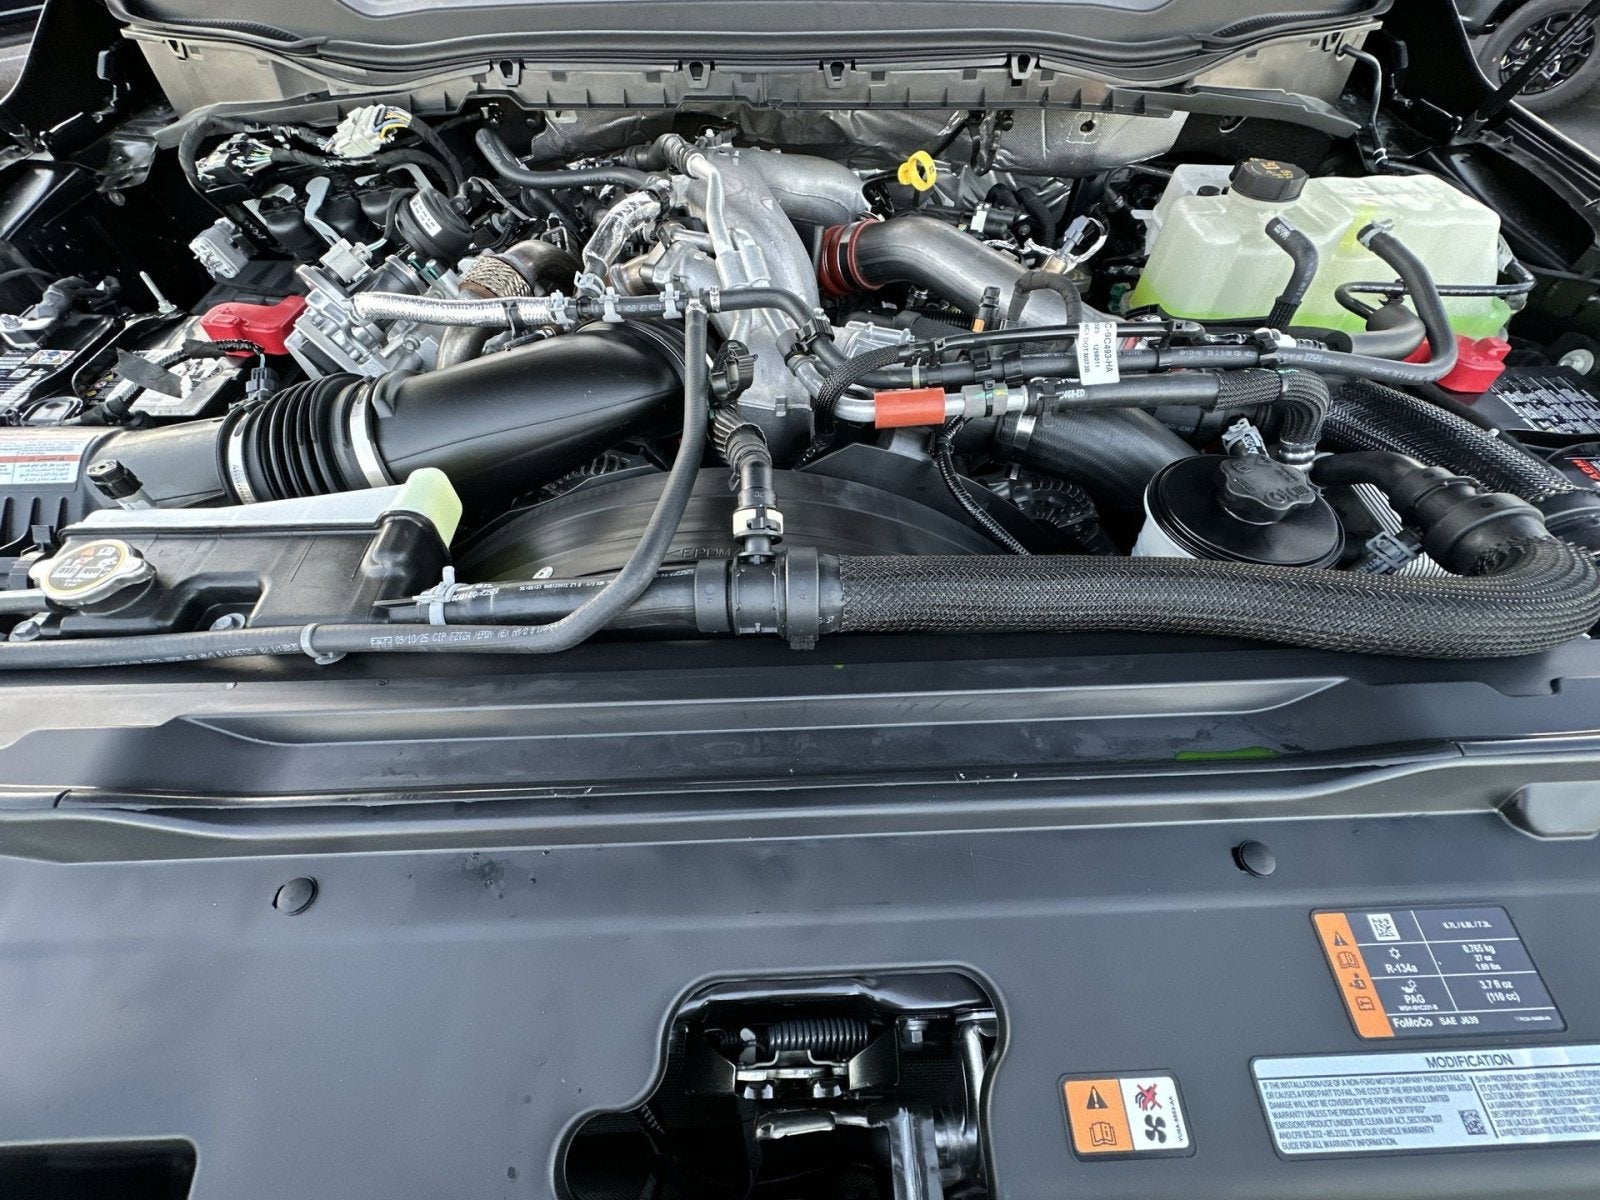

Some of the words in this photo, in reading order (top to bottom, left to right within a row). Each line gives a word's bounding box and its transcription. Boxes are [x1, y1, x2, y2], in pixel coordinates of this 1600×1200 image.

[1484, 944, 1496, 954] kg
[1385, 963, 1419, 974] R-134a
[1480, 980, 1492, 989] 3.7
[1502, 981, 1514, 989] oz
[1404, 994, 1426, 1004] PAG
[1486, 992, 1505, 1004] (110
[1506, 991, 1521, 1003] cc)
[1392, 1017, 1434, 1028] FoMoCo
[1439, 1017, 1458, 1026] SAE
[1425, 1054, 1515, 1069] MODIFICATION
